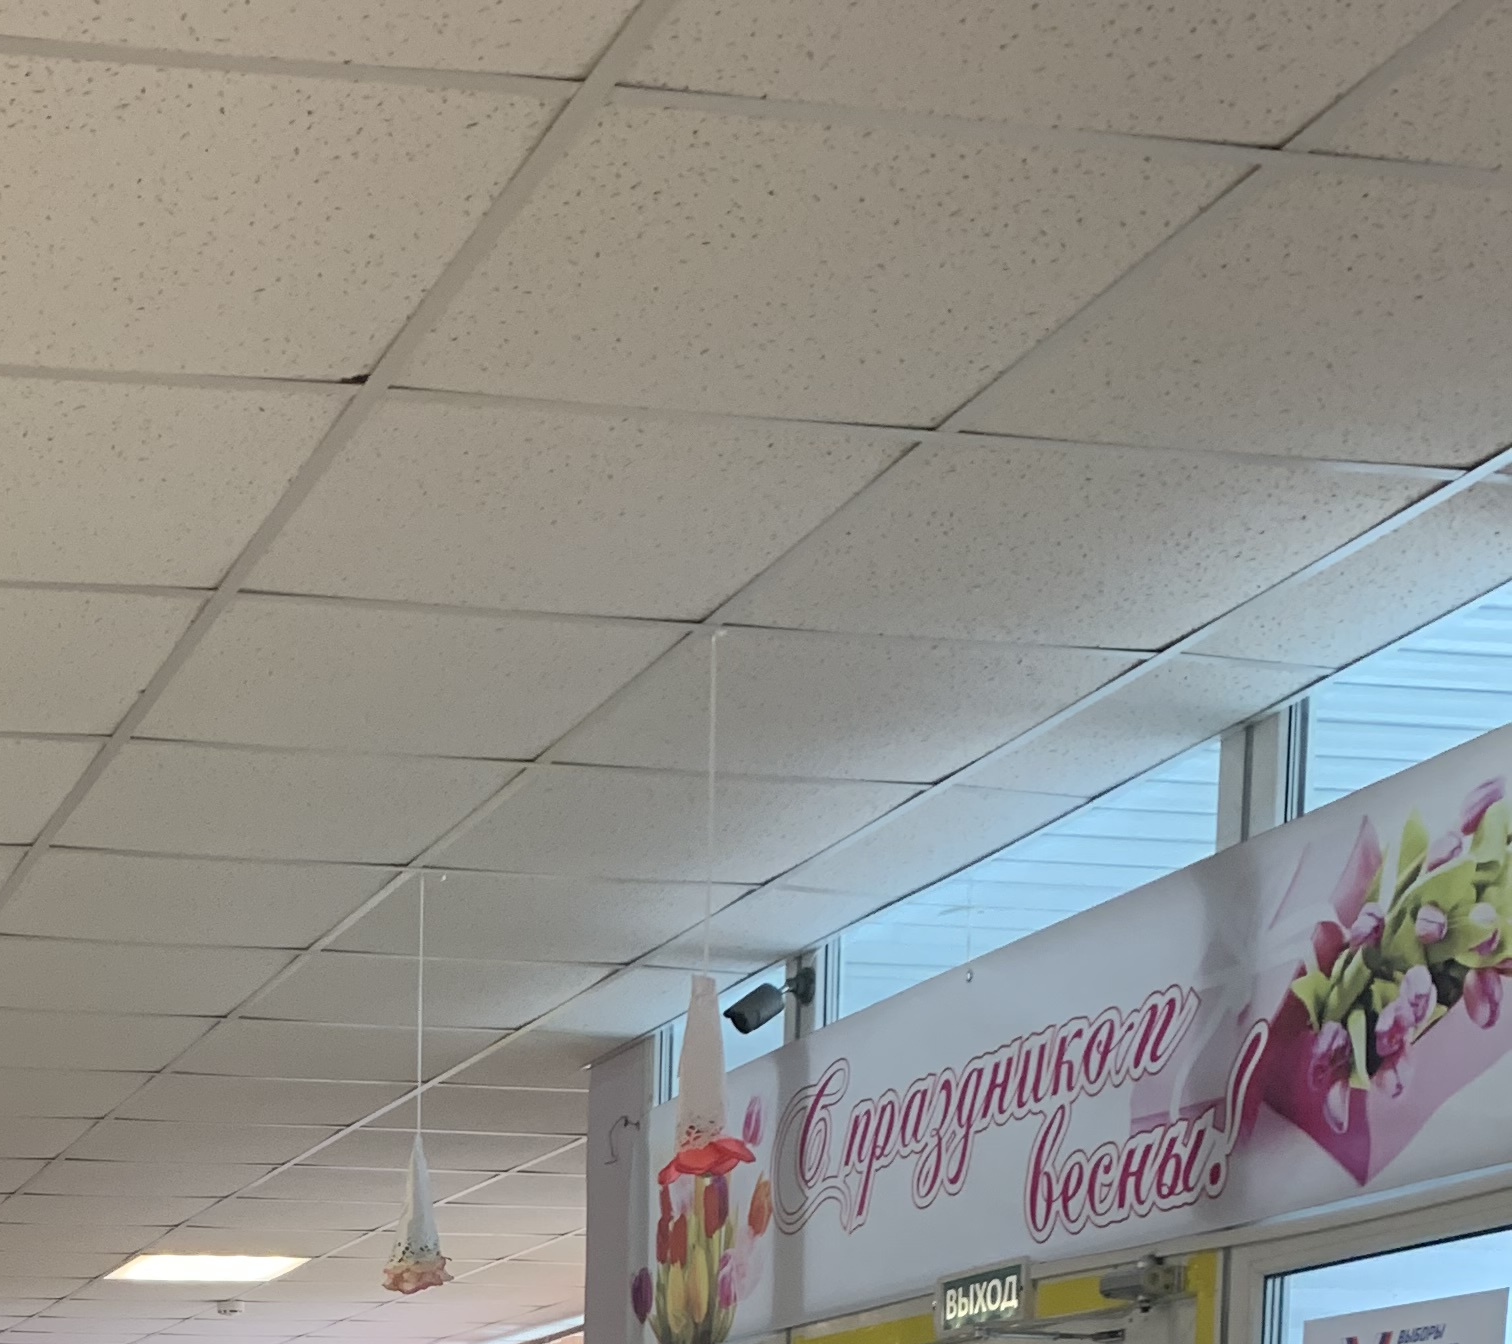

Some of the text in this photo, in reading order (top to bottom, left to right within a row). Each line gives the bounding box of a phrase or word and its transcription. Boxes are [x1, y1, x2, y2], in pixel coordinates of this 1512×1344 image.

[843, 990, 1188, 1225] праздником
[1026, 1024, 1268, 1236] весны!
[945, 1274, 1019, 1321] ВЫХОД
[1397, 1323, 1446, 1344] ВЫБОРЫ
